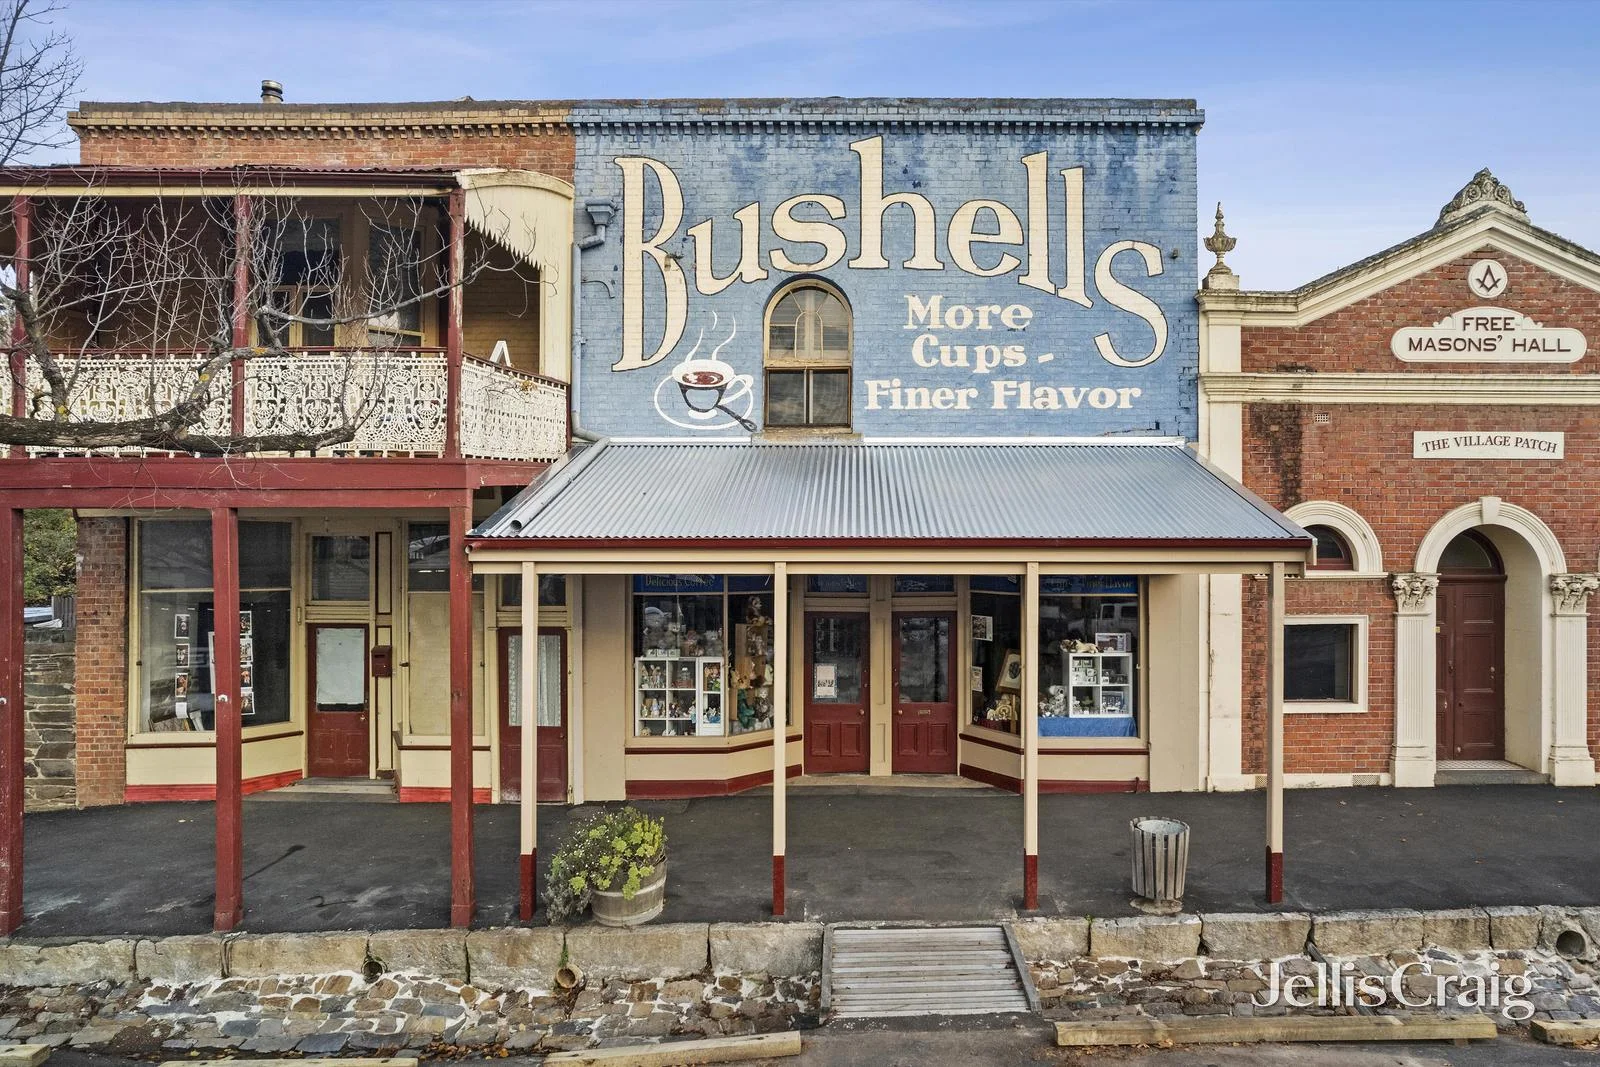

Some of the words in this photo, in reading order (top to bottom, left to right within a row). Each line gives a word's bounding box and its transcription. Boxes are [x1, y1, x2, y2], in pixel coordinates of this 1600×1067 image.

[612, 135, 1168, 372] Bushells
[904, 294, 1033, 329] More
[1462, 317, 1515, 331] FREE
[911, 333, 1026, 373] Cups
[1408, 335, 1502, 352] MASONS'
[1512, 338, 1571, 352] HALL
[864, 378, 978, 411] Finer
[991, 379, 1142, 410] Flavor
[1422, 438, 1450, 453] THE
[1454, 435, 1511, 448] VILLAGE
[1515, 438, 1558, 453] PATCH
